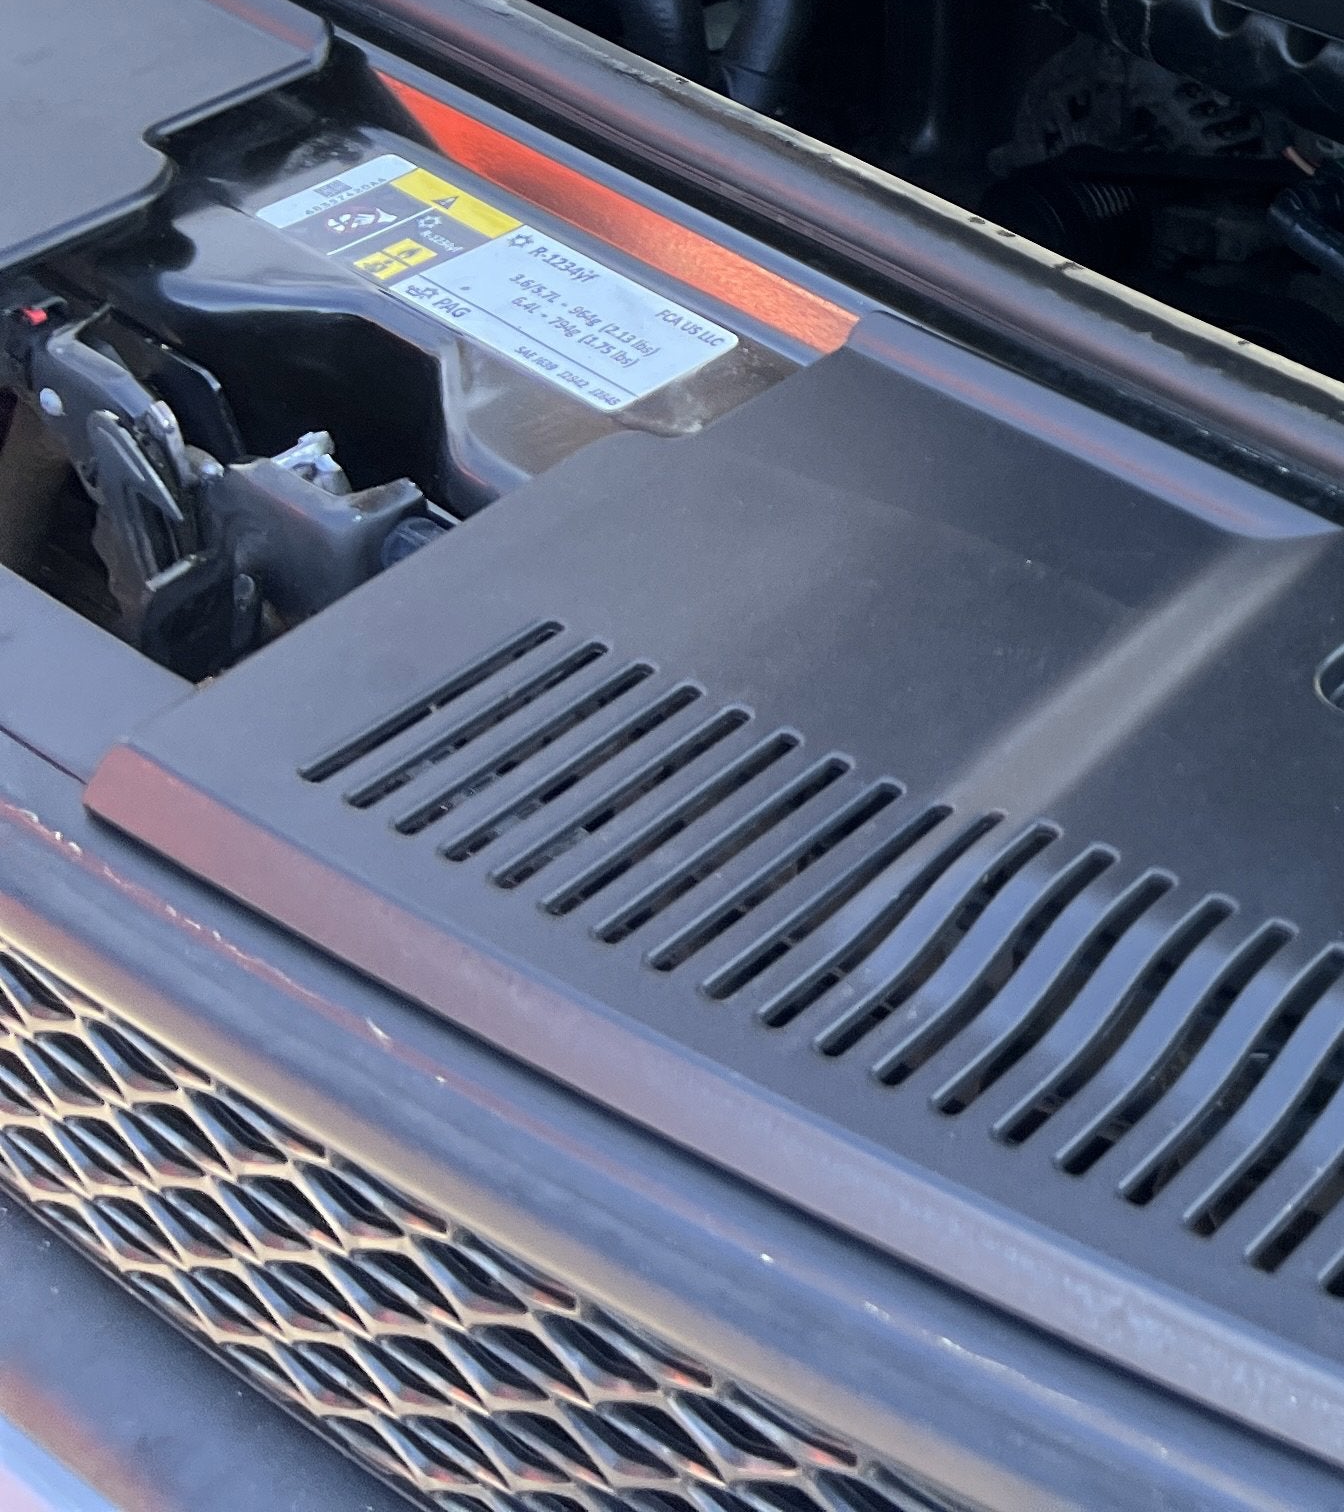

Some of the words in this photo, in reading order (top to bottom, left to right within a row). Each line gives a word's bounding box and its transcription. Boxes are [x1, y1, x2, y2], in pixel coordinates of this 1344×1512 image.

[528, 246, 600, 283] R-1234yf
[432, 298, 472, 318] PAG
[508, 273, 562, 304] 3.6/5.7L
[568, 306, 602, 328] 964g
[597, 323, 637, 344] (2.13
[630, 339, 661, 358] lbs)
[512, 296, 542, 315] 6.4L
[548, 316, 582, 338] 794g
[577, 333, 617, 355] (1.75
[609, 350, 640, 368] lbs)
[654, 309, 684, 326] FCA
[680, 321, 703, 335] US
[698, 331, 725, 346] LLC
[514, 345, 538, 359] SAE
